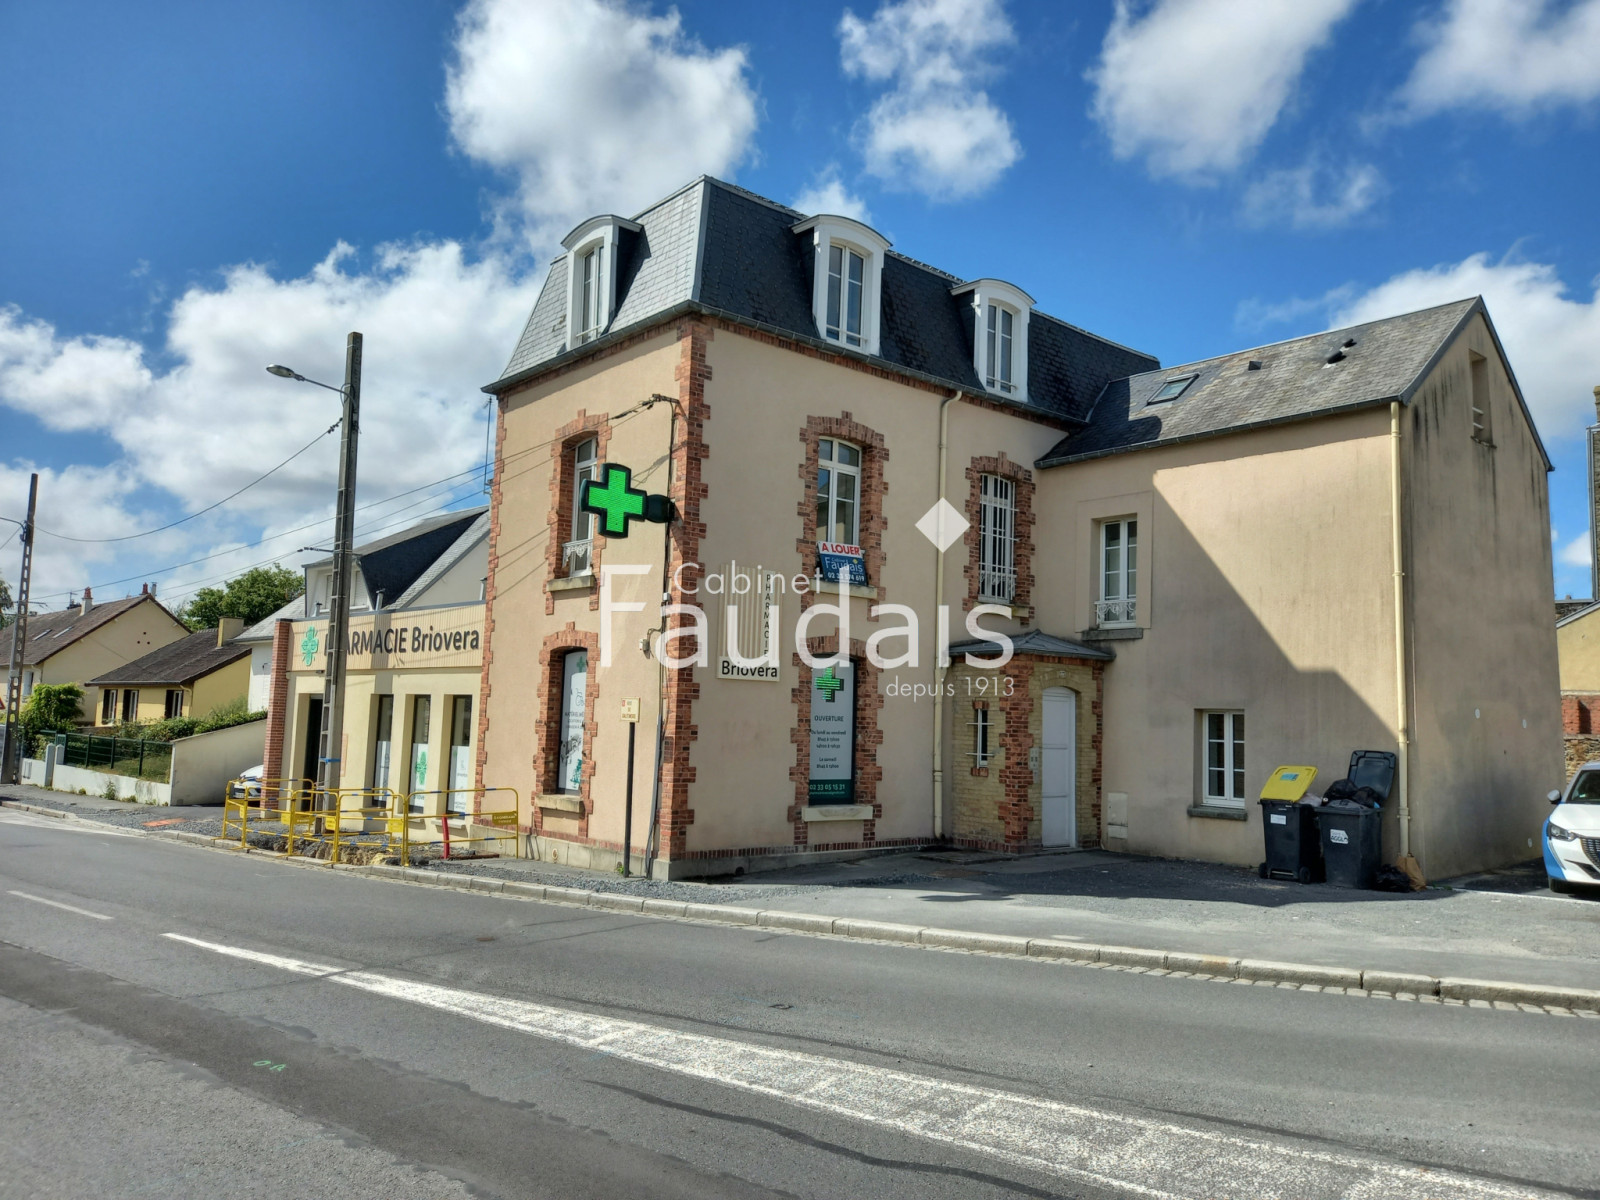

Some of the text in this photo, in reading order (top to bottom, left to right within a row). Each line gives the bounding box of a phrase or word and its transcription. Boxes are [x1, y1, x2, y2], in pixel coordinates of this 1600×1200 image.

[822, 543, 861, 556] A LOUER
[825, 557, 863, 573] Faudais
[411, 626, 480, 653] Briovera
[721, 660, 778, 678] Briovera
